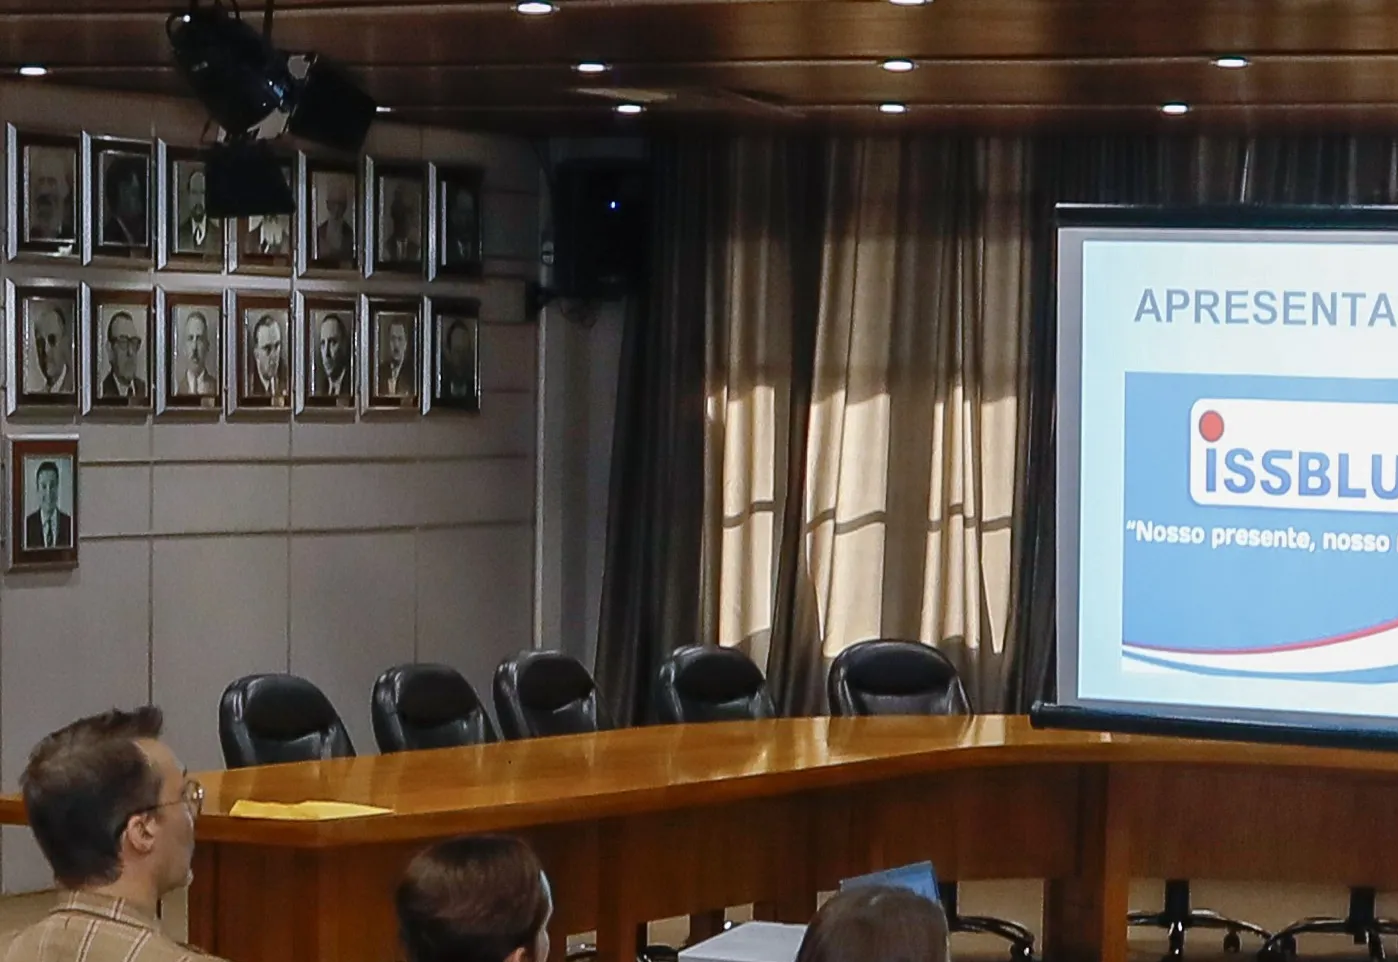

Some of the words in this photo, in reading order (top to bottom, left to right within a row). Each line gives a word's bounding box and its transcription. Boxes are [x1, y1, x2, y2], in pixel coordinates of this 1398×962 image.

[1126, 519, 1205, 544] "Nosso
[1211, 526, 1315, 552] presente,
[1323, 532, 1389, 552] nosso
